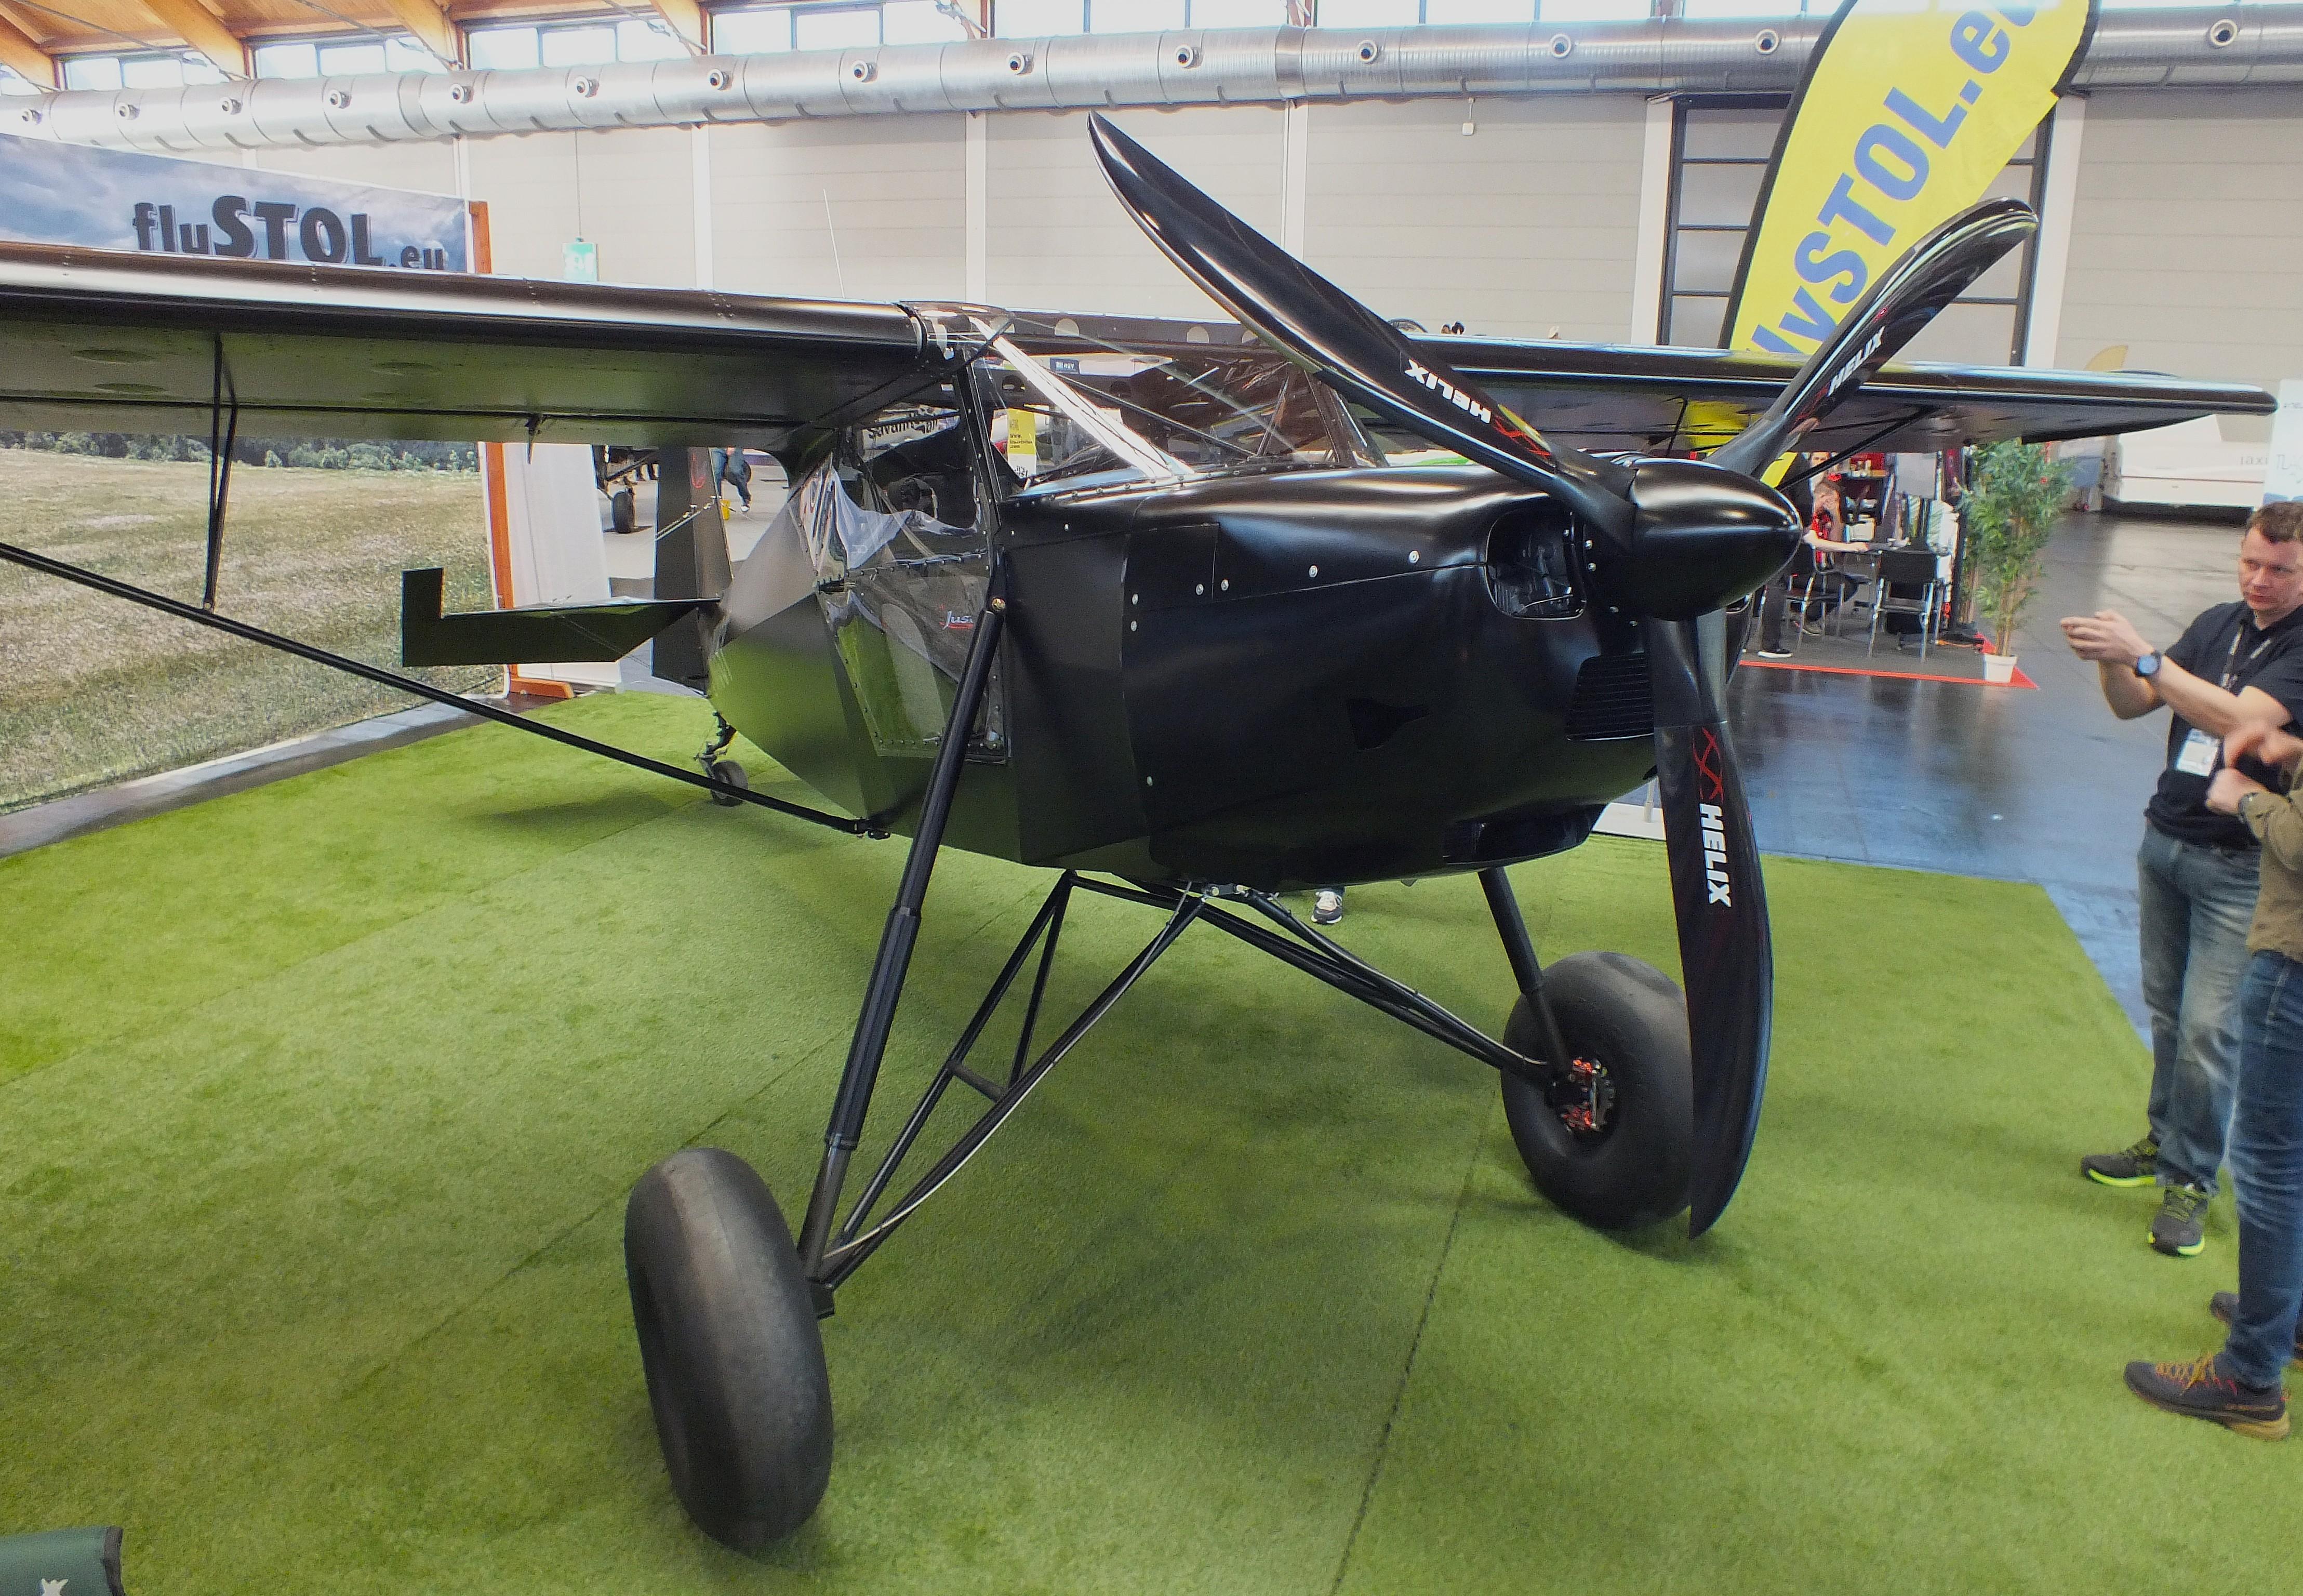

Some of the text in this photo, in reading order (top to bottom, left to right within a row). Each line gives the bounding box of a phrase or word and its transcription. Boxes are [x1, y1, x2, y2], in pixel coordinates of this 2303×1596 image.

[1404, 358, 1491, 423] HELIX
[1827, 326, 1885, 397] HELIX
[1699, 803, 1732, 908] HELIX
